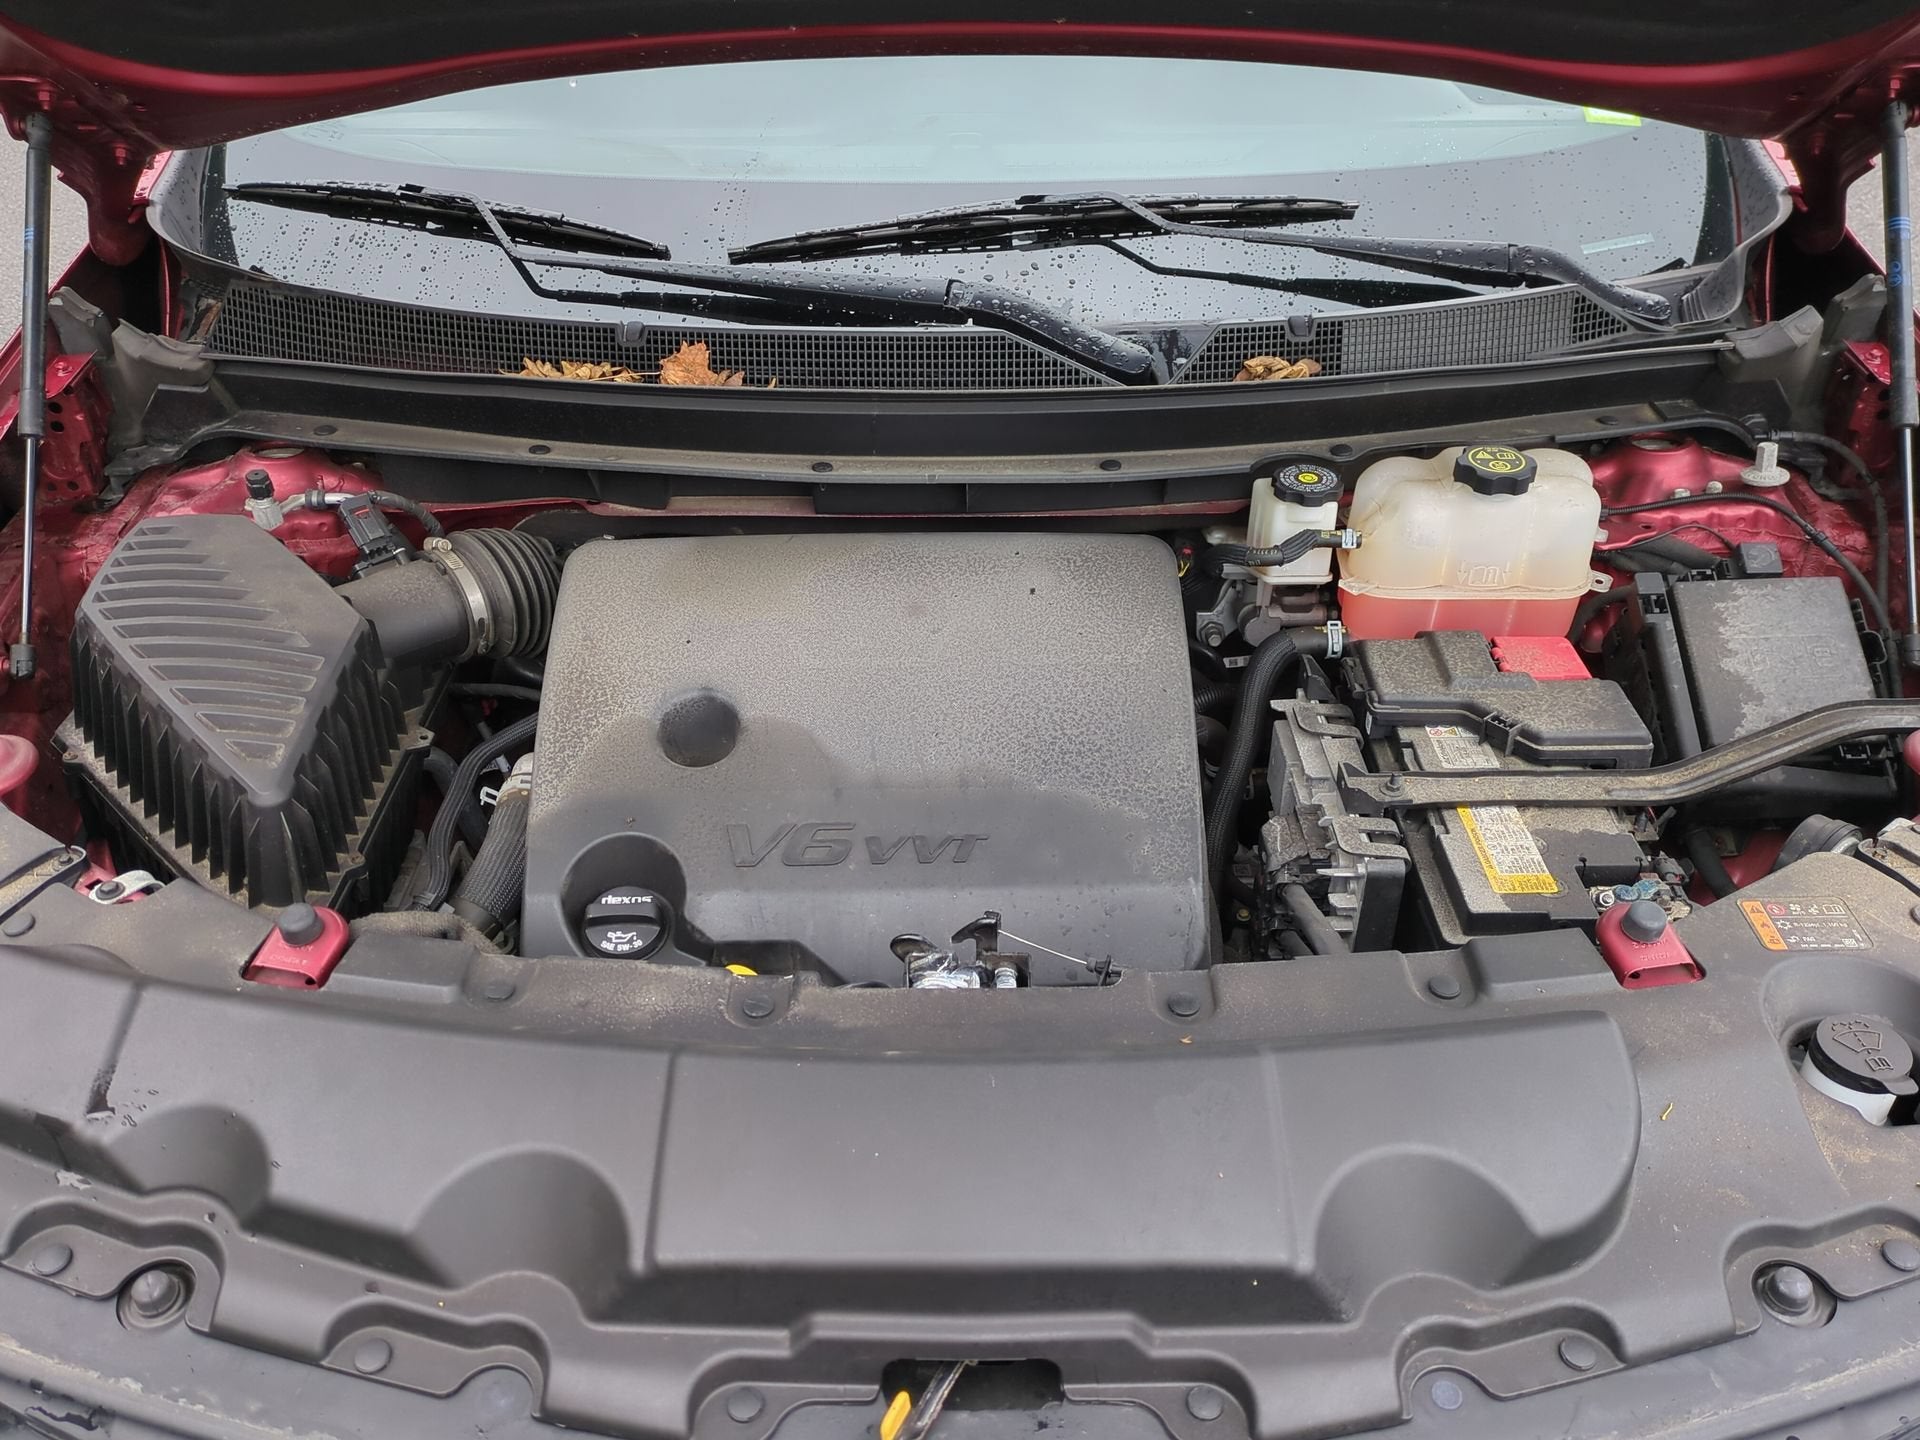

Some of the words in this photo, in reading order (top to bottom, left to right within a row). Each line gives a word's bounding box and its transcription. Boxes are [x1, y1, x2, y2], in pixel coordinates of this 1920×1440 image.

[727, 822, 856, 867] V6
[865, 834, 990, 865] VVT
[600, 940, 616, 951] SAE
[616, 939, 643, 952] 5W-30
